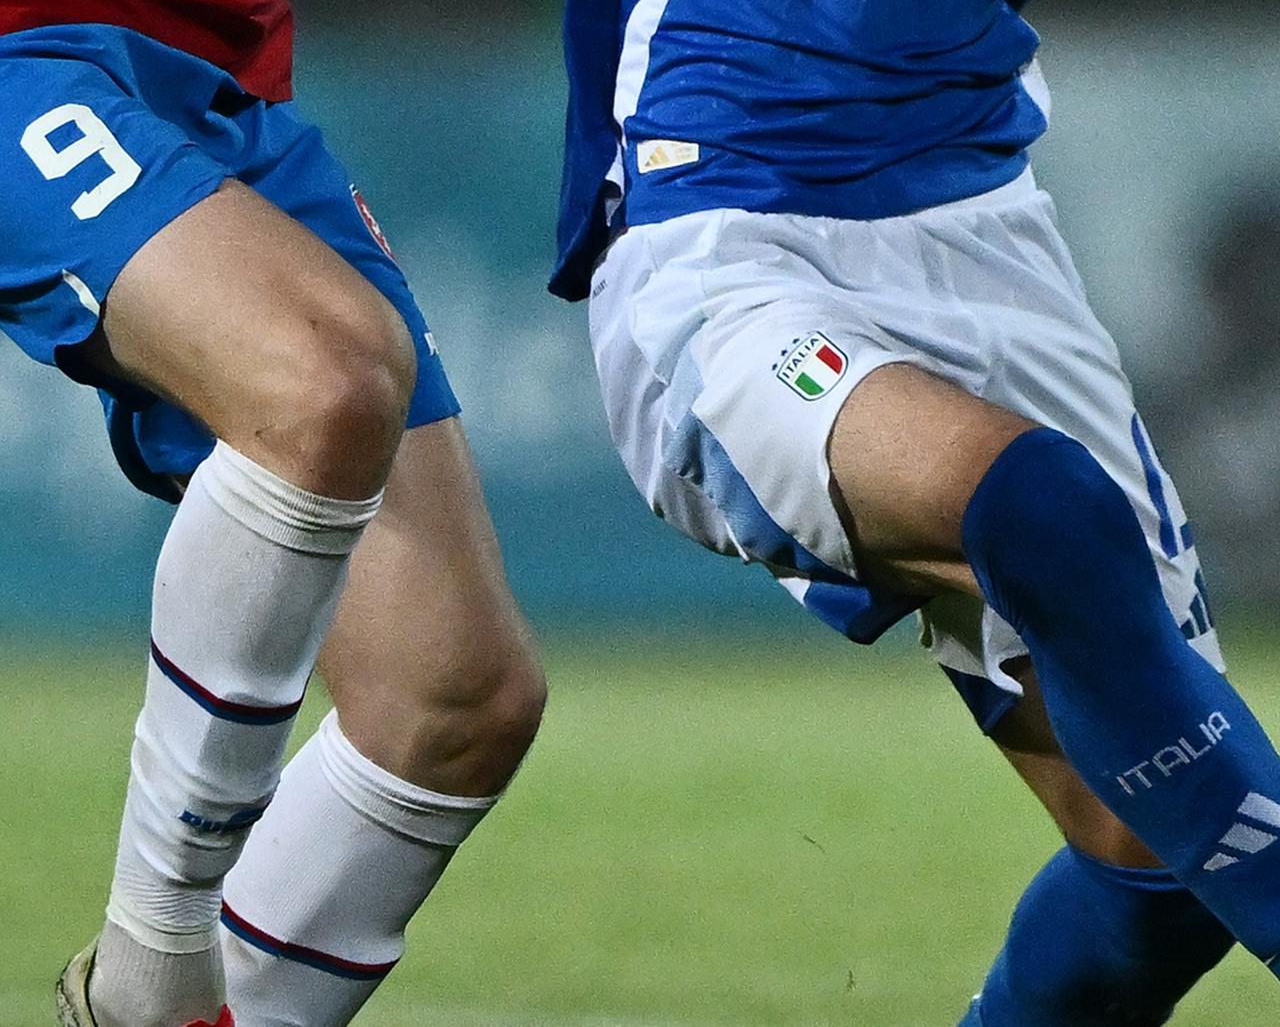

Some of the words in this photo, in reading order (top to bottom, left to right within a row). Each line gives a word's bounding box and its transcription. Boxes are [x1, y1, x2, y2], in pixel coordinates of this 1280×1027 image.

[19, 103, 143, 221] 9
[781, 337, 820, 380] ITALIA
[1116, 711, 1232, 796] ITALIA
